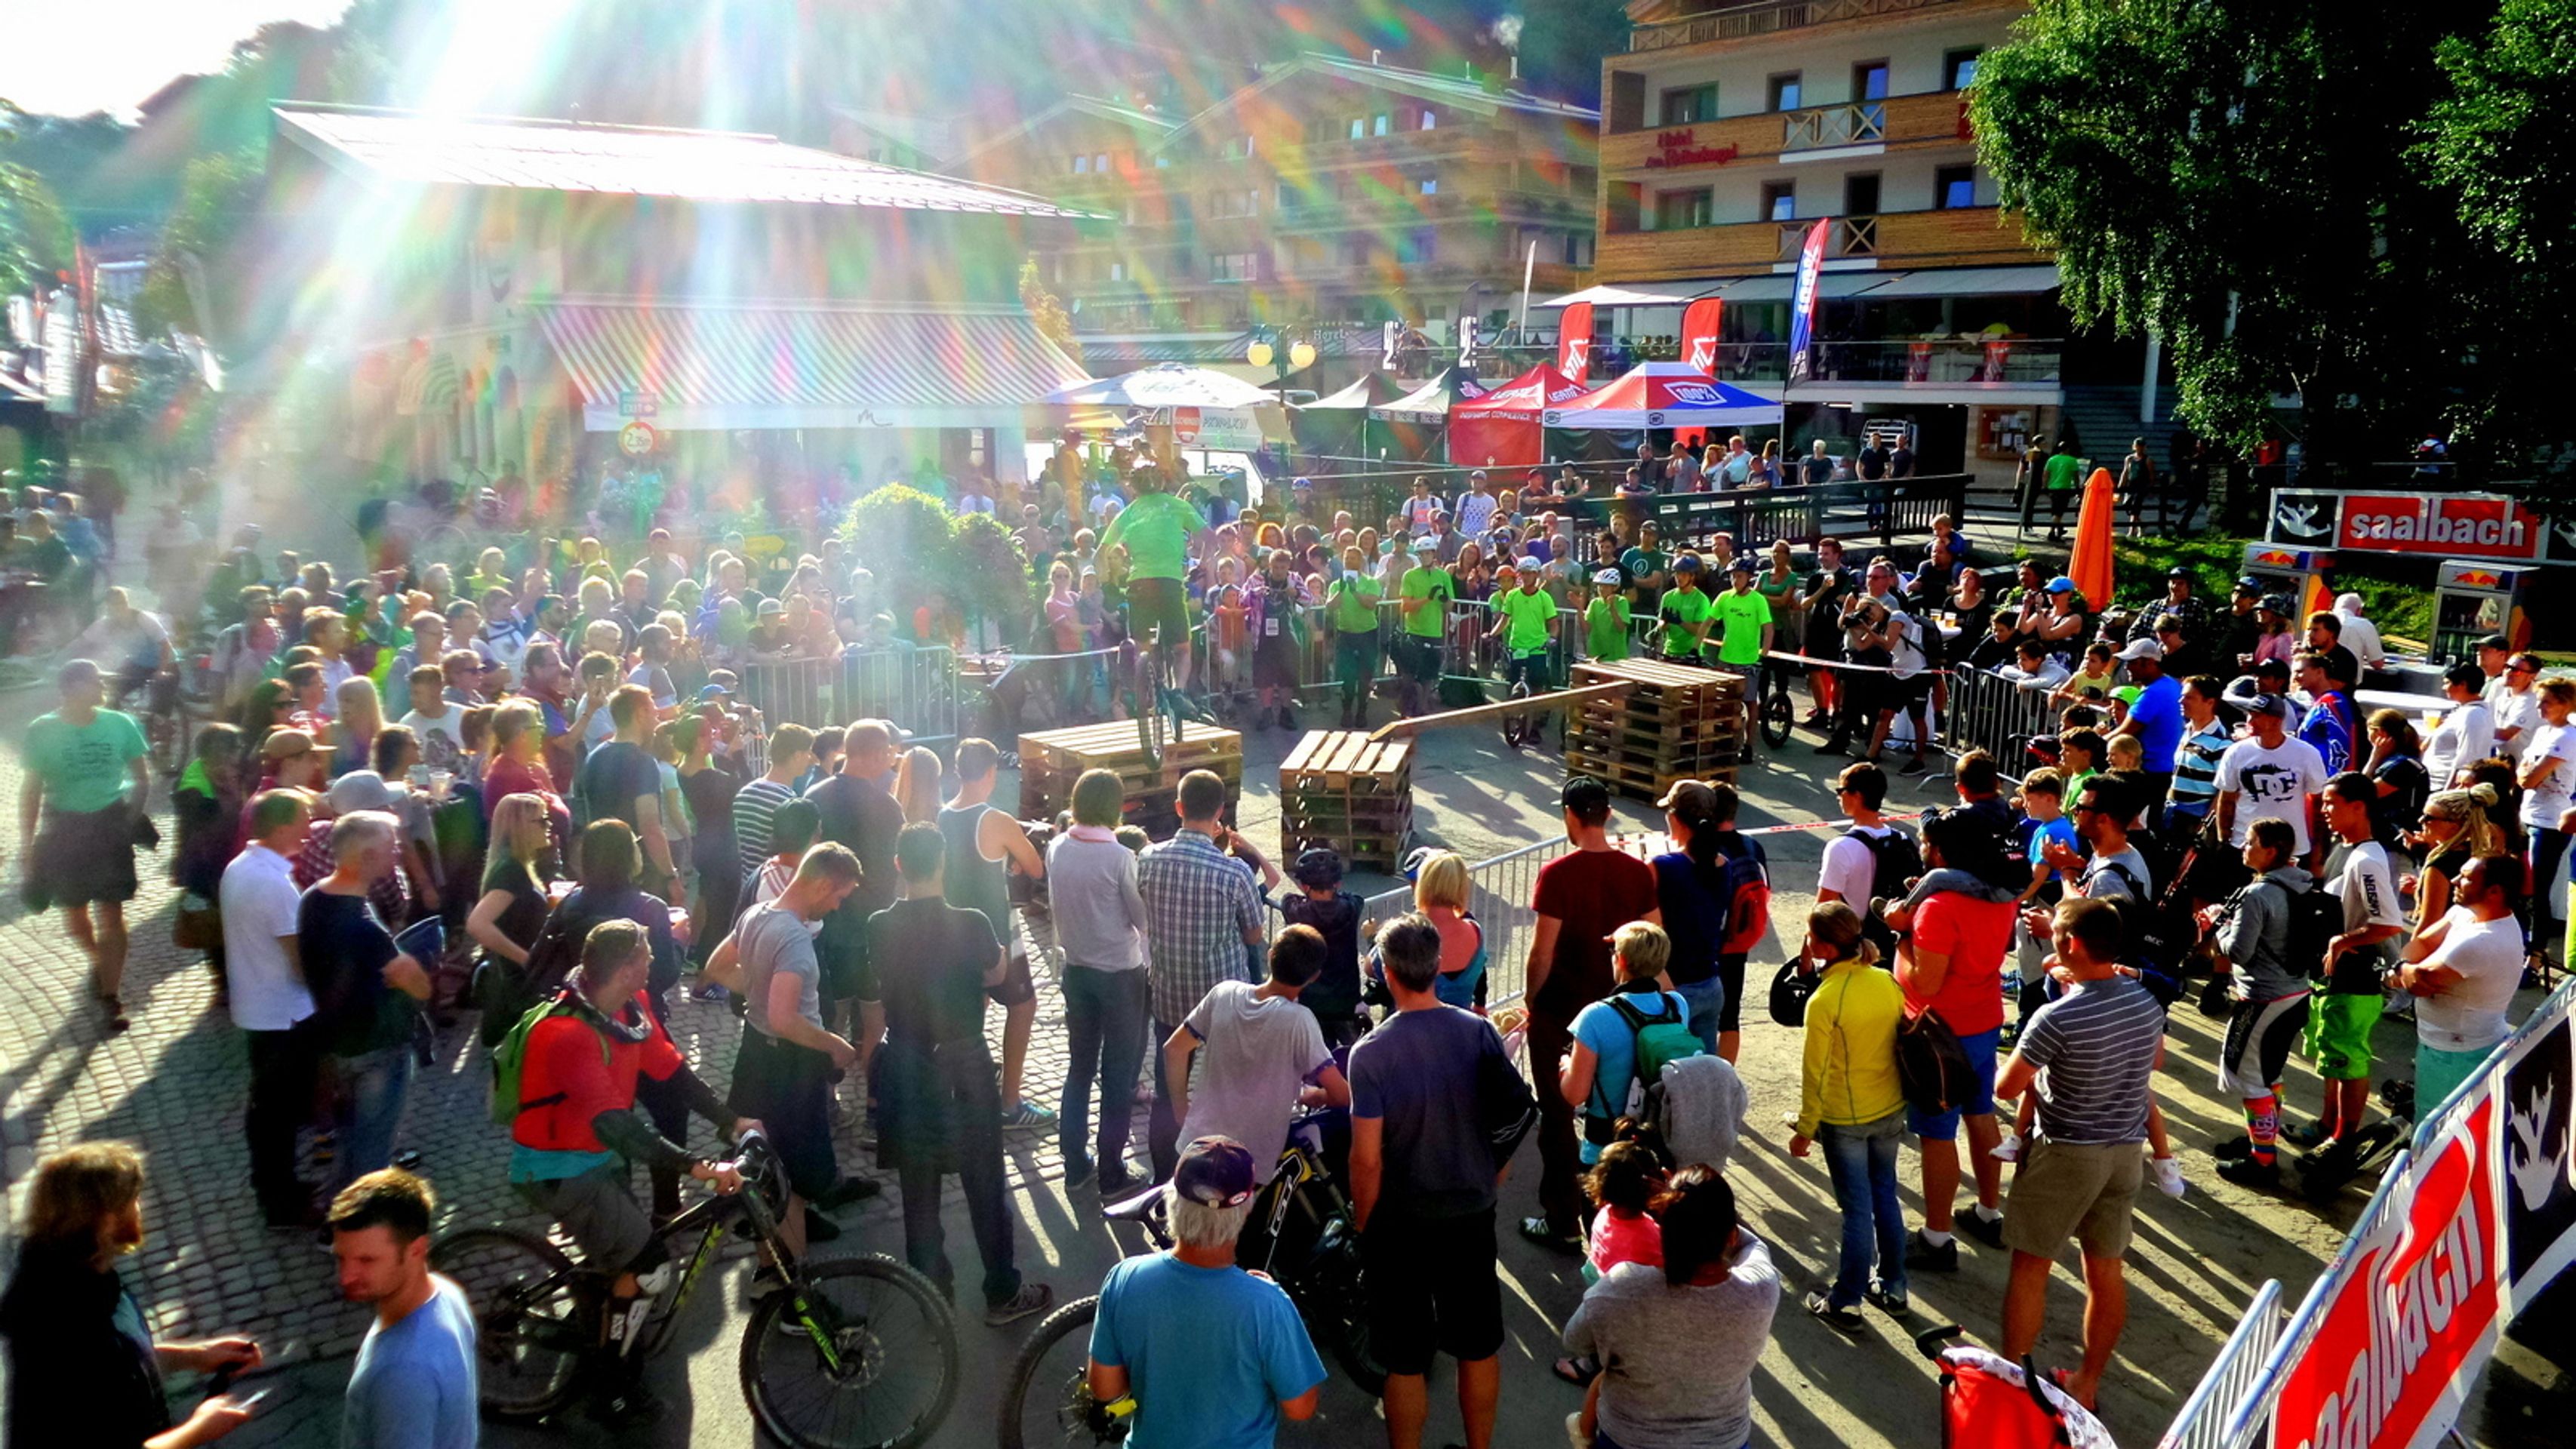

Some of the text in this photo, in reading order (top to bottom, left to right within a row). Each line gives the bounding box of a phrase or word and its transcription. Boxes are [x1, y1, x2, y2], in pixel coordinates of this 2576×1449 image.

[1675, 386, 1716, 401] 100%
[2350, 496, 2524, 547] saalbach
[2297, 1186, 2482, 1449] aalbach
